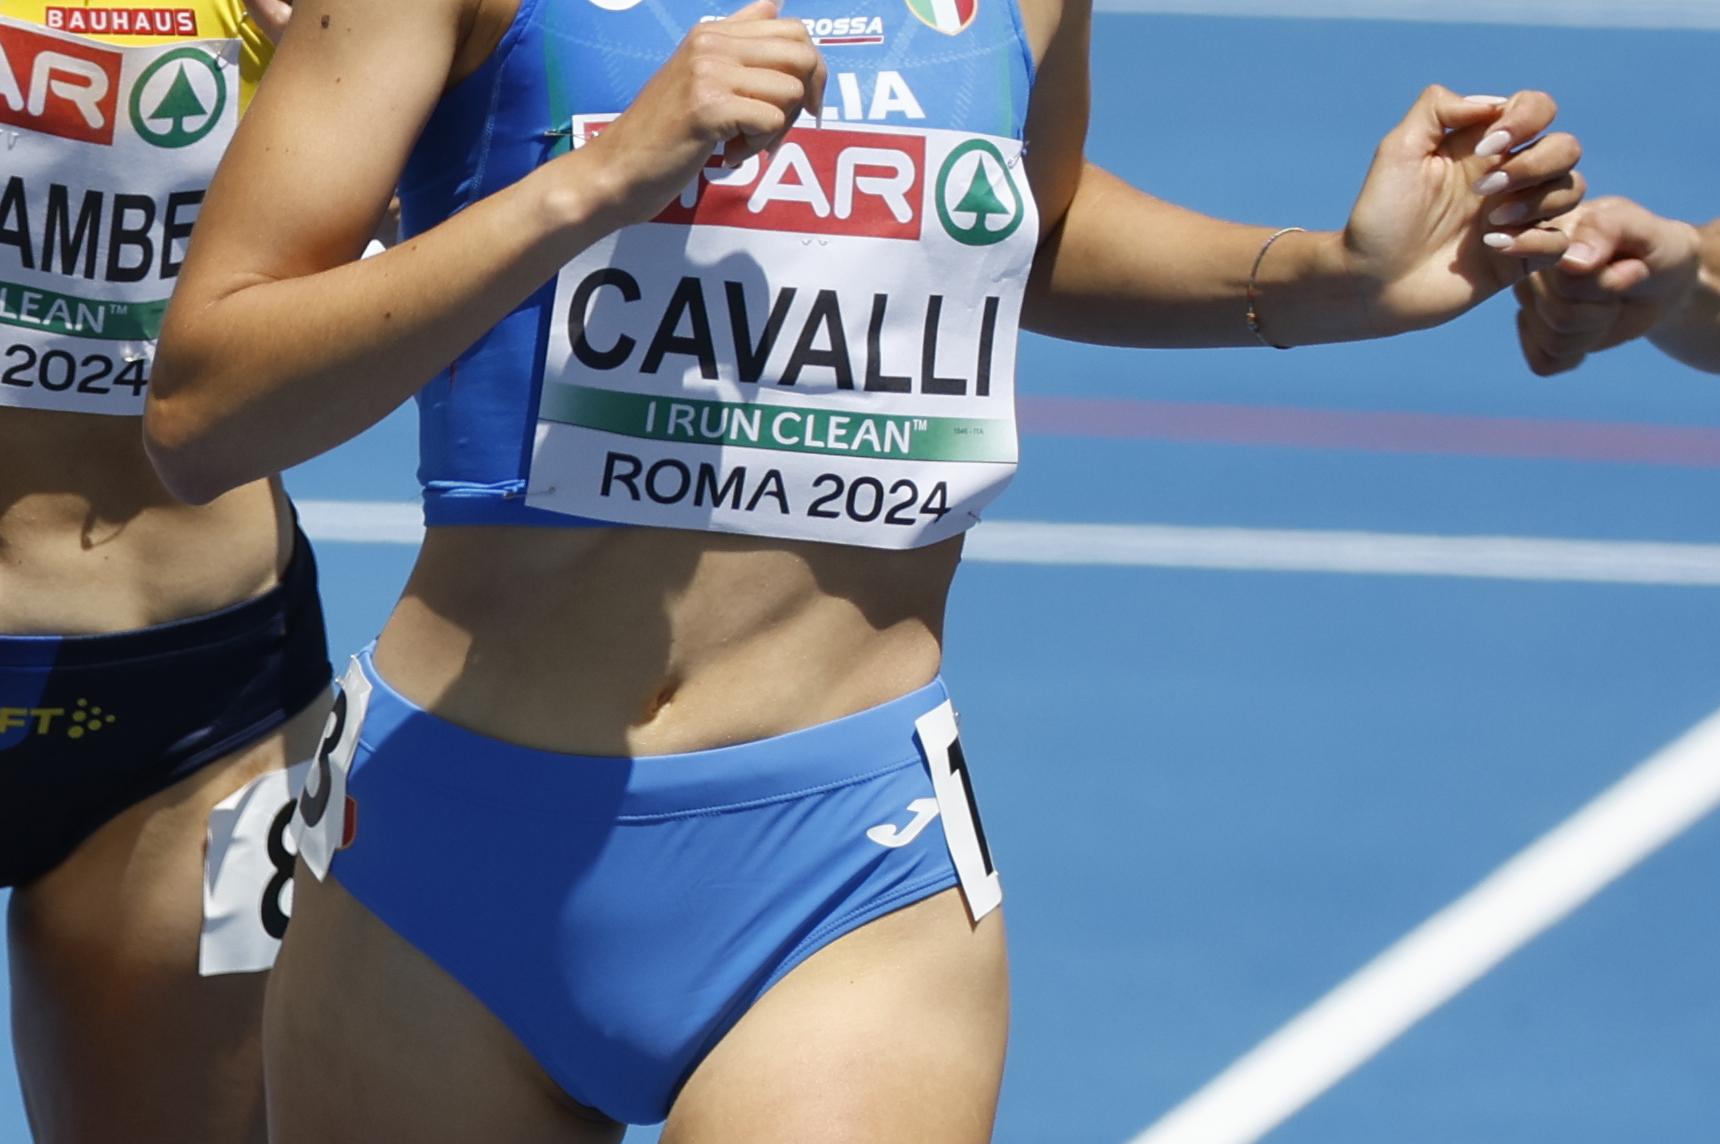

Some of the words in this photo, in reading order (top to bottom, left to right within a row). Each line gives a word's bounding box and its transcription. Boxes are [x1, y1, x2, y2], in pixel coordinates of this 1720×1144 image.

[46, 8, 195, 33] BAUHAUS
[567, 267, 1000, 398] CAVALLI
[0, 342, 149, 397] 2024
[644, 400, 658, 434] I
[665, 400, 760, 442] RUN
[599, 450, 790, 515] ROMA
[807, 473, 953, 528] 2024
